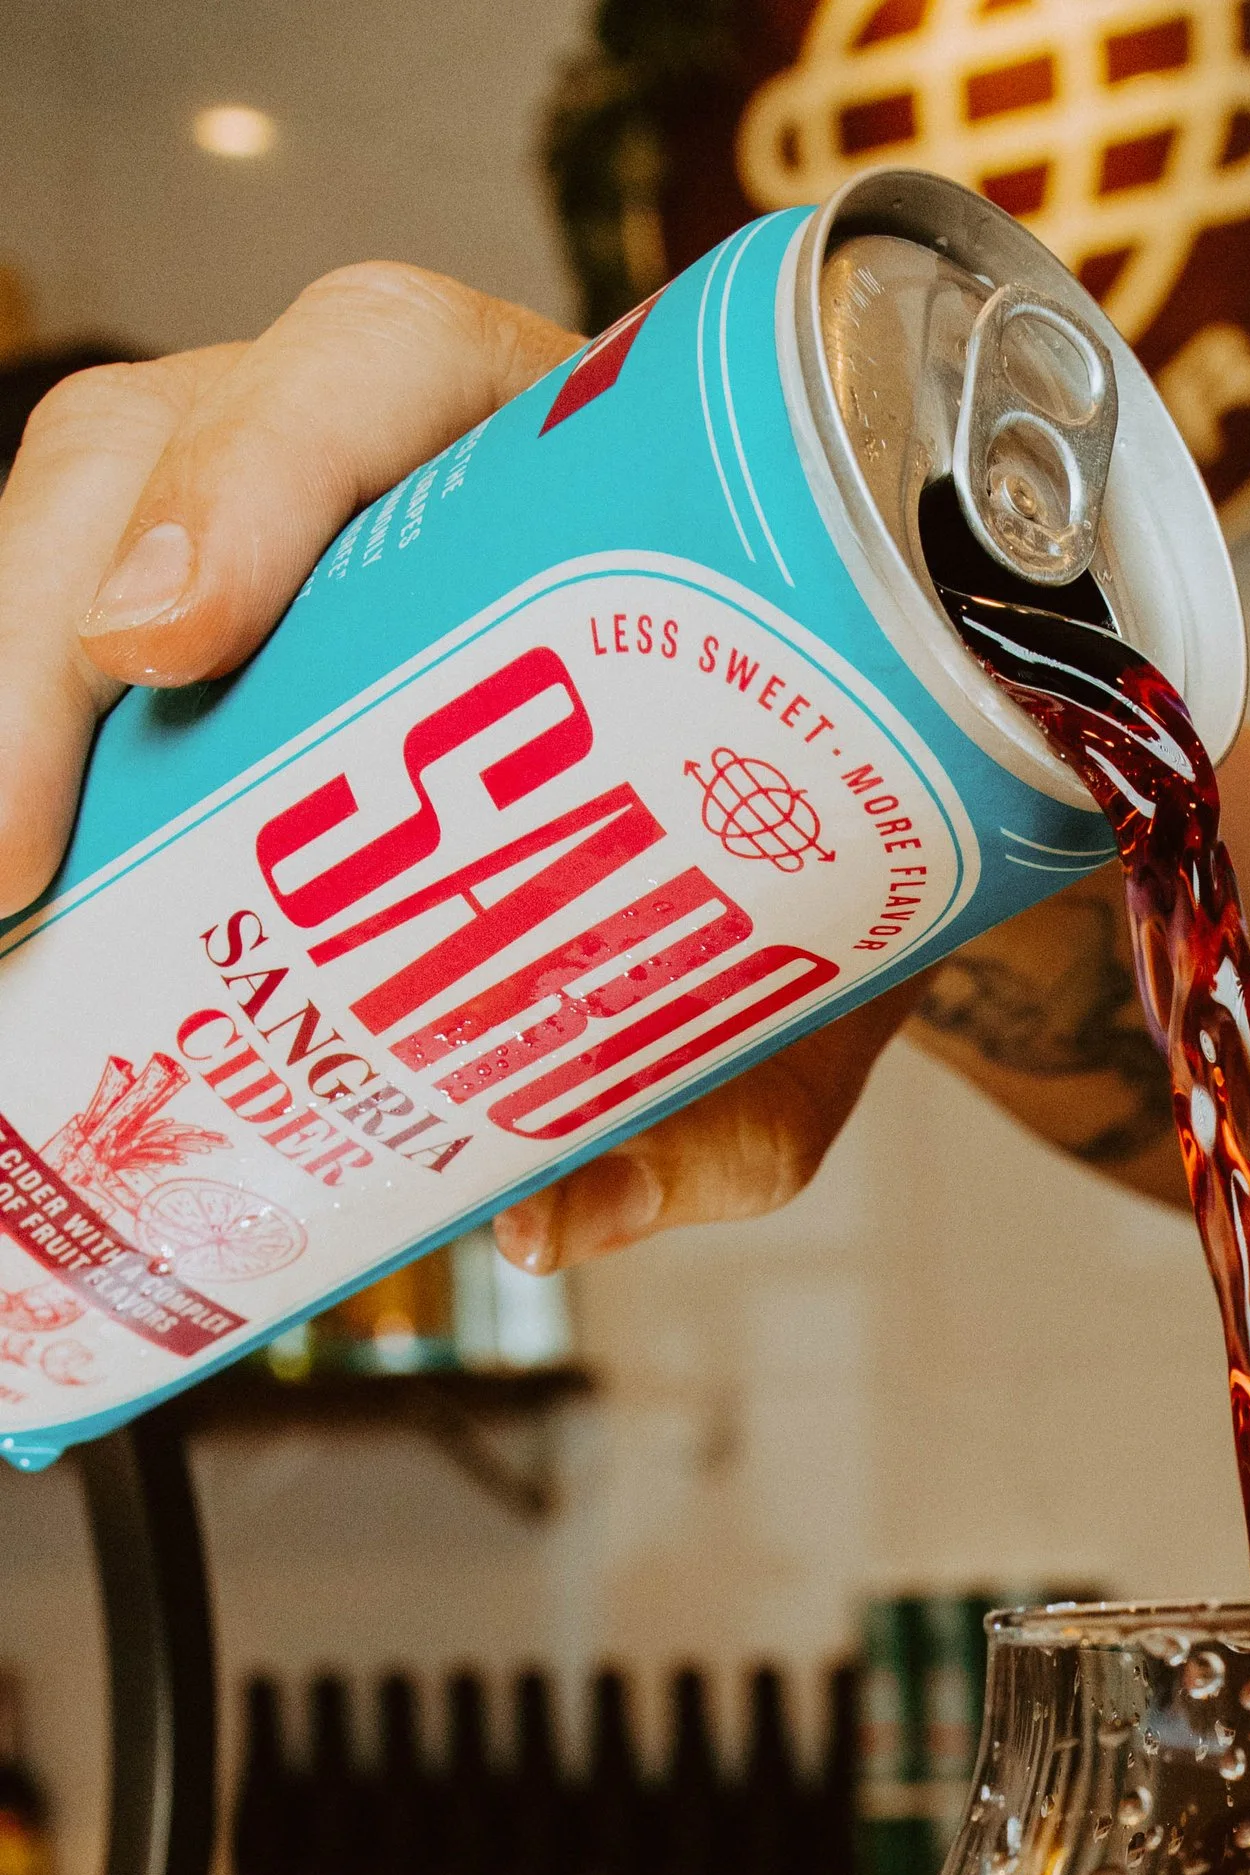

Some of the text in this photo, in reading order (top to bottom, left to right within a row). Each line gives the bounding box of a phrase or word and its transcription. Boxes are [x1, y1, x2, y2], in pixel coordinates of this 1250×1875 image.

[361, 469, 418, 568] MMONLY
[399, 469, 438, 549] GRAPES
[590, 613, 928, 952] LESS SWEET MORE FLAVOR
[255, 645, 841, 1141] SARO
[176, 1008, 375, 1188] CIDER
[199, 909, 475, 1175] SANGRIA
[0, 1148, 69, 1218] CIDER
[63, 1213, 128, 1269] WITH
[119, 1264, 146, 1284] A
[19, 1212, 92, 1272] FRUIT
[82, 1267, 180, 1334] FLAVORS
